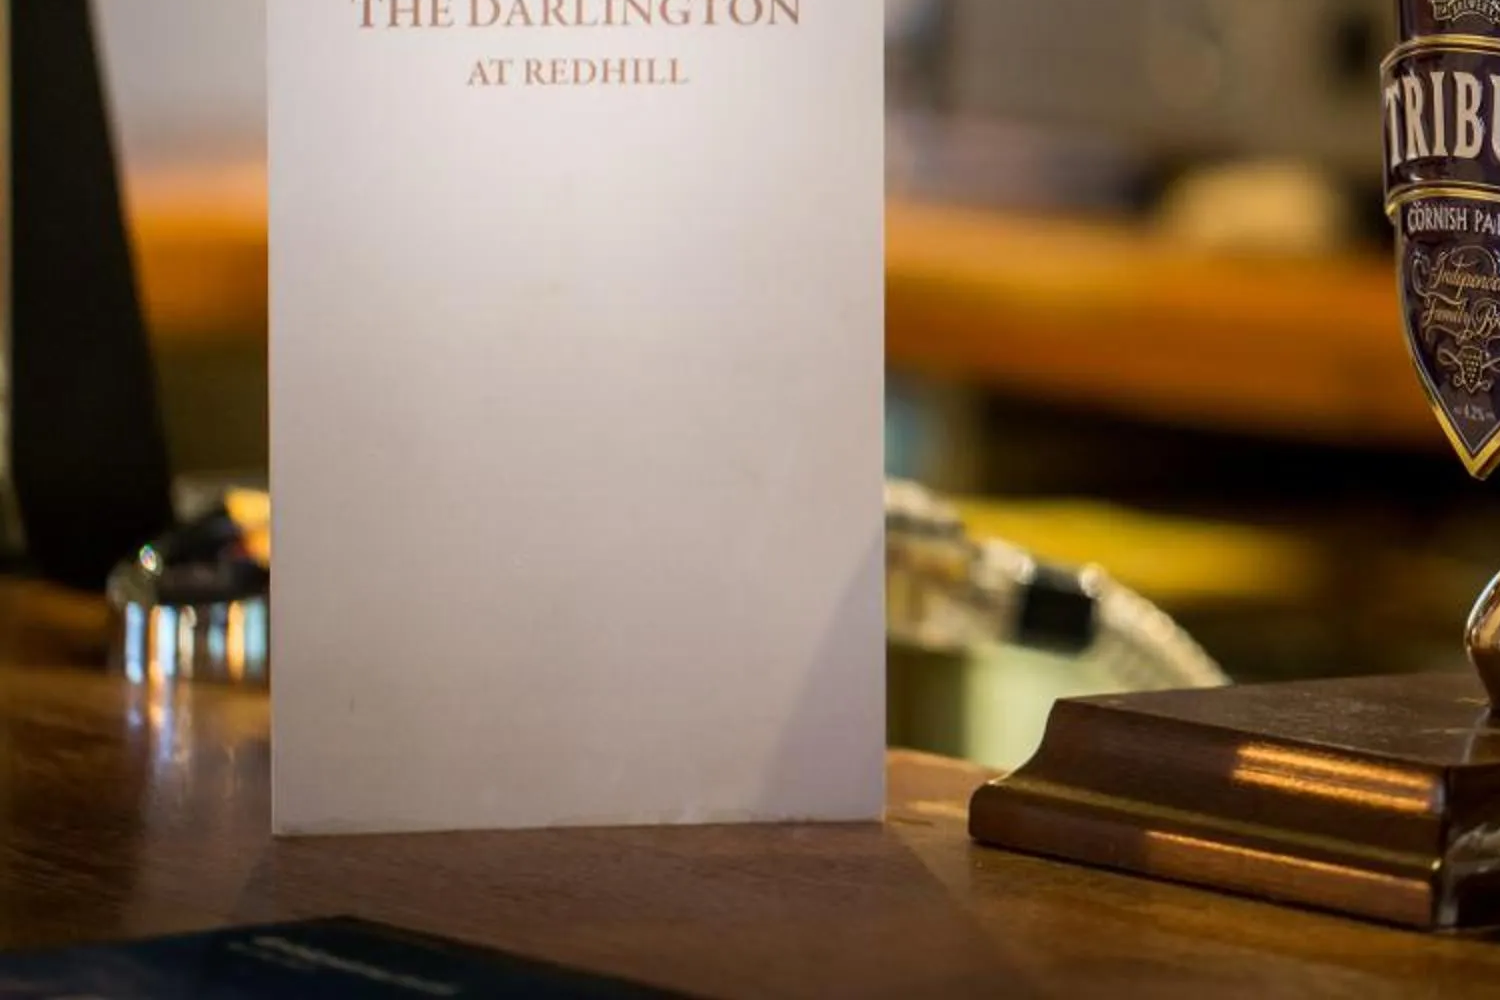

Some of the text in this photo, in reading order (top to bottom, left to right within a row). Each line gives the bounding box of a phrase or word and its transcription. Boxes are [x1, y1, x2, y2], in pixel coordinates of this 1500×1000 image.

[467, 58, 689, 86] AT REDHILL
[1407, 205, 1468, 232] CORNISH
